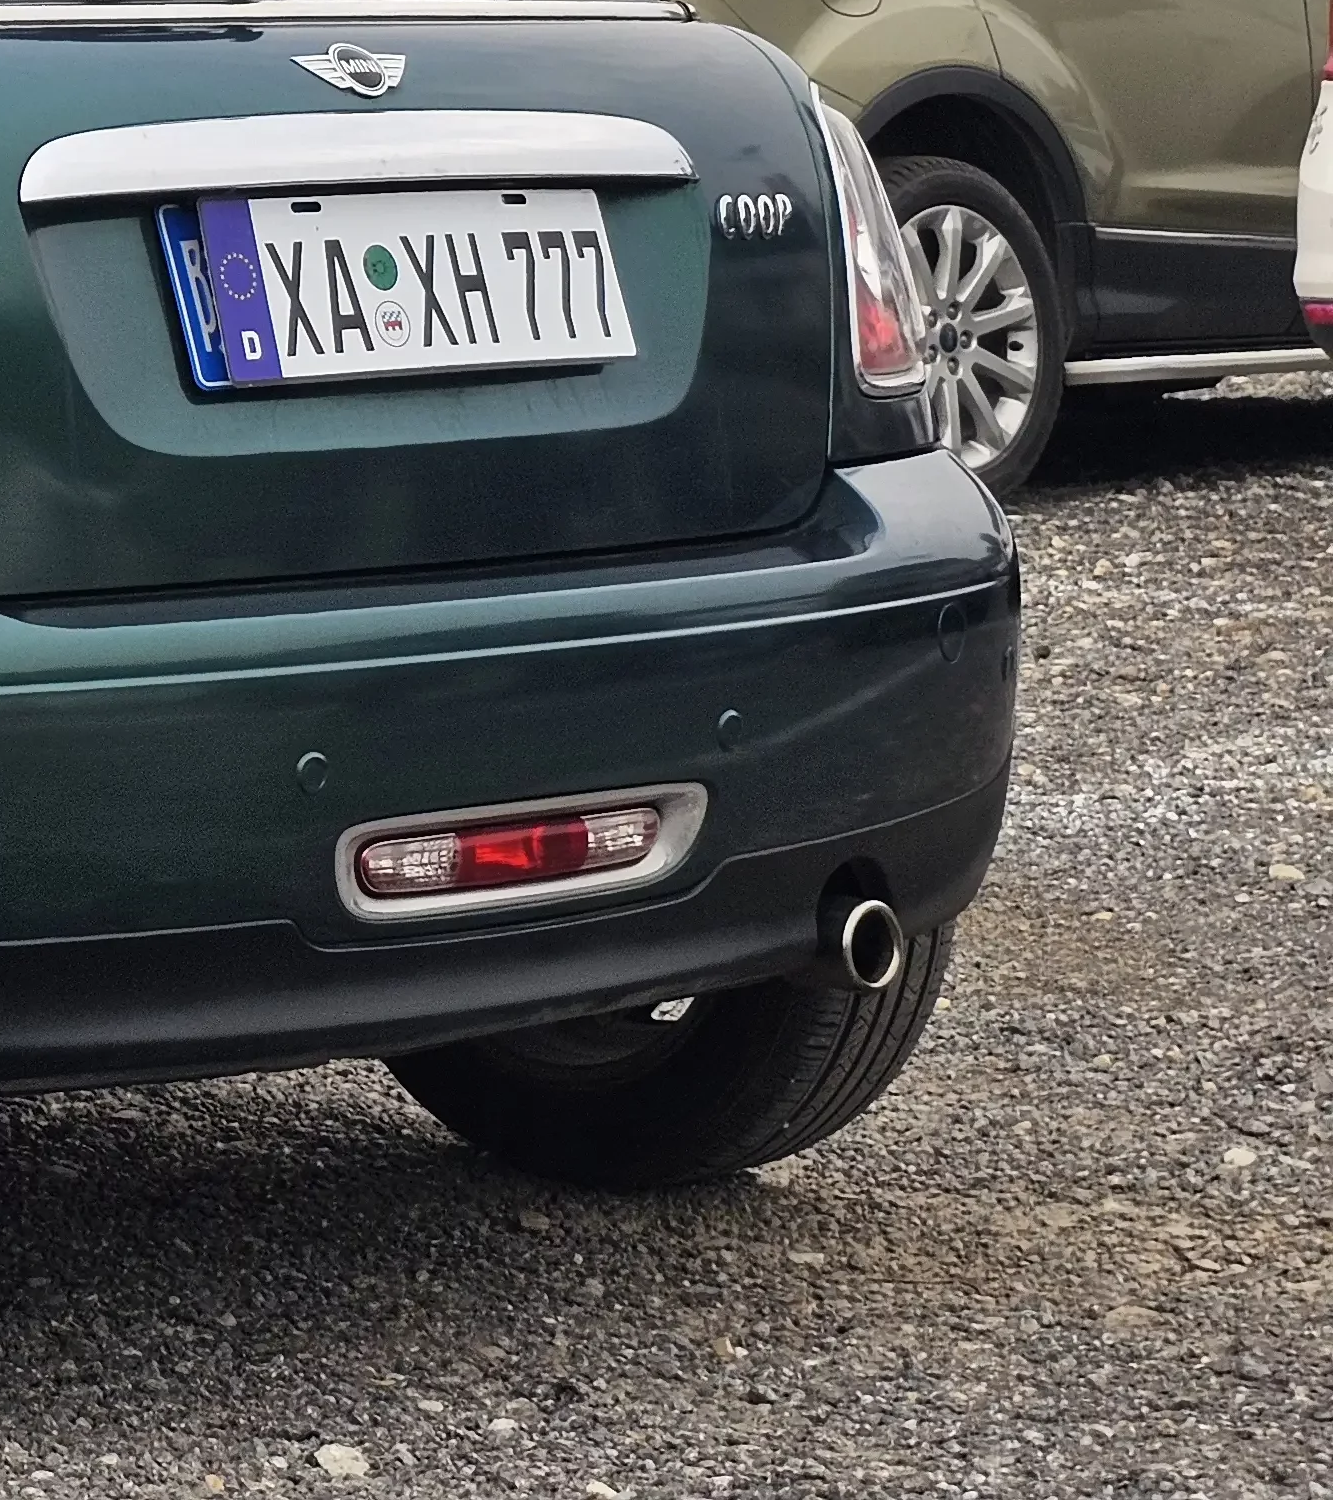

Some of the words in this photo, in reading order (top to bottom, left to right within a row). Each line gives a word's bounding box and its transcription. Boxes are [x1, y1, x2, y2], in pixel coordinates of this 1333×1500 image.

[716, 193, 793, 240] COOP
[264, 239, 375, 357] XA
[399, 232, 501, 348] XH
[501, 230, 613, 341] 777
[241, 330, 262, 360] D
